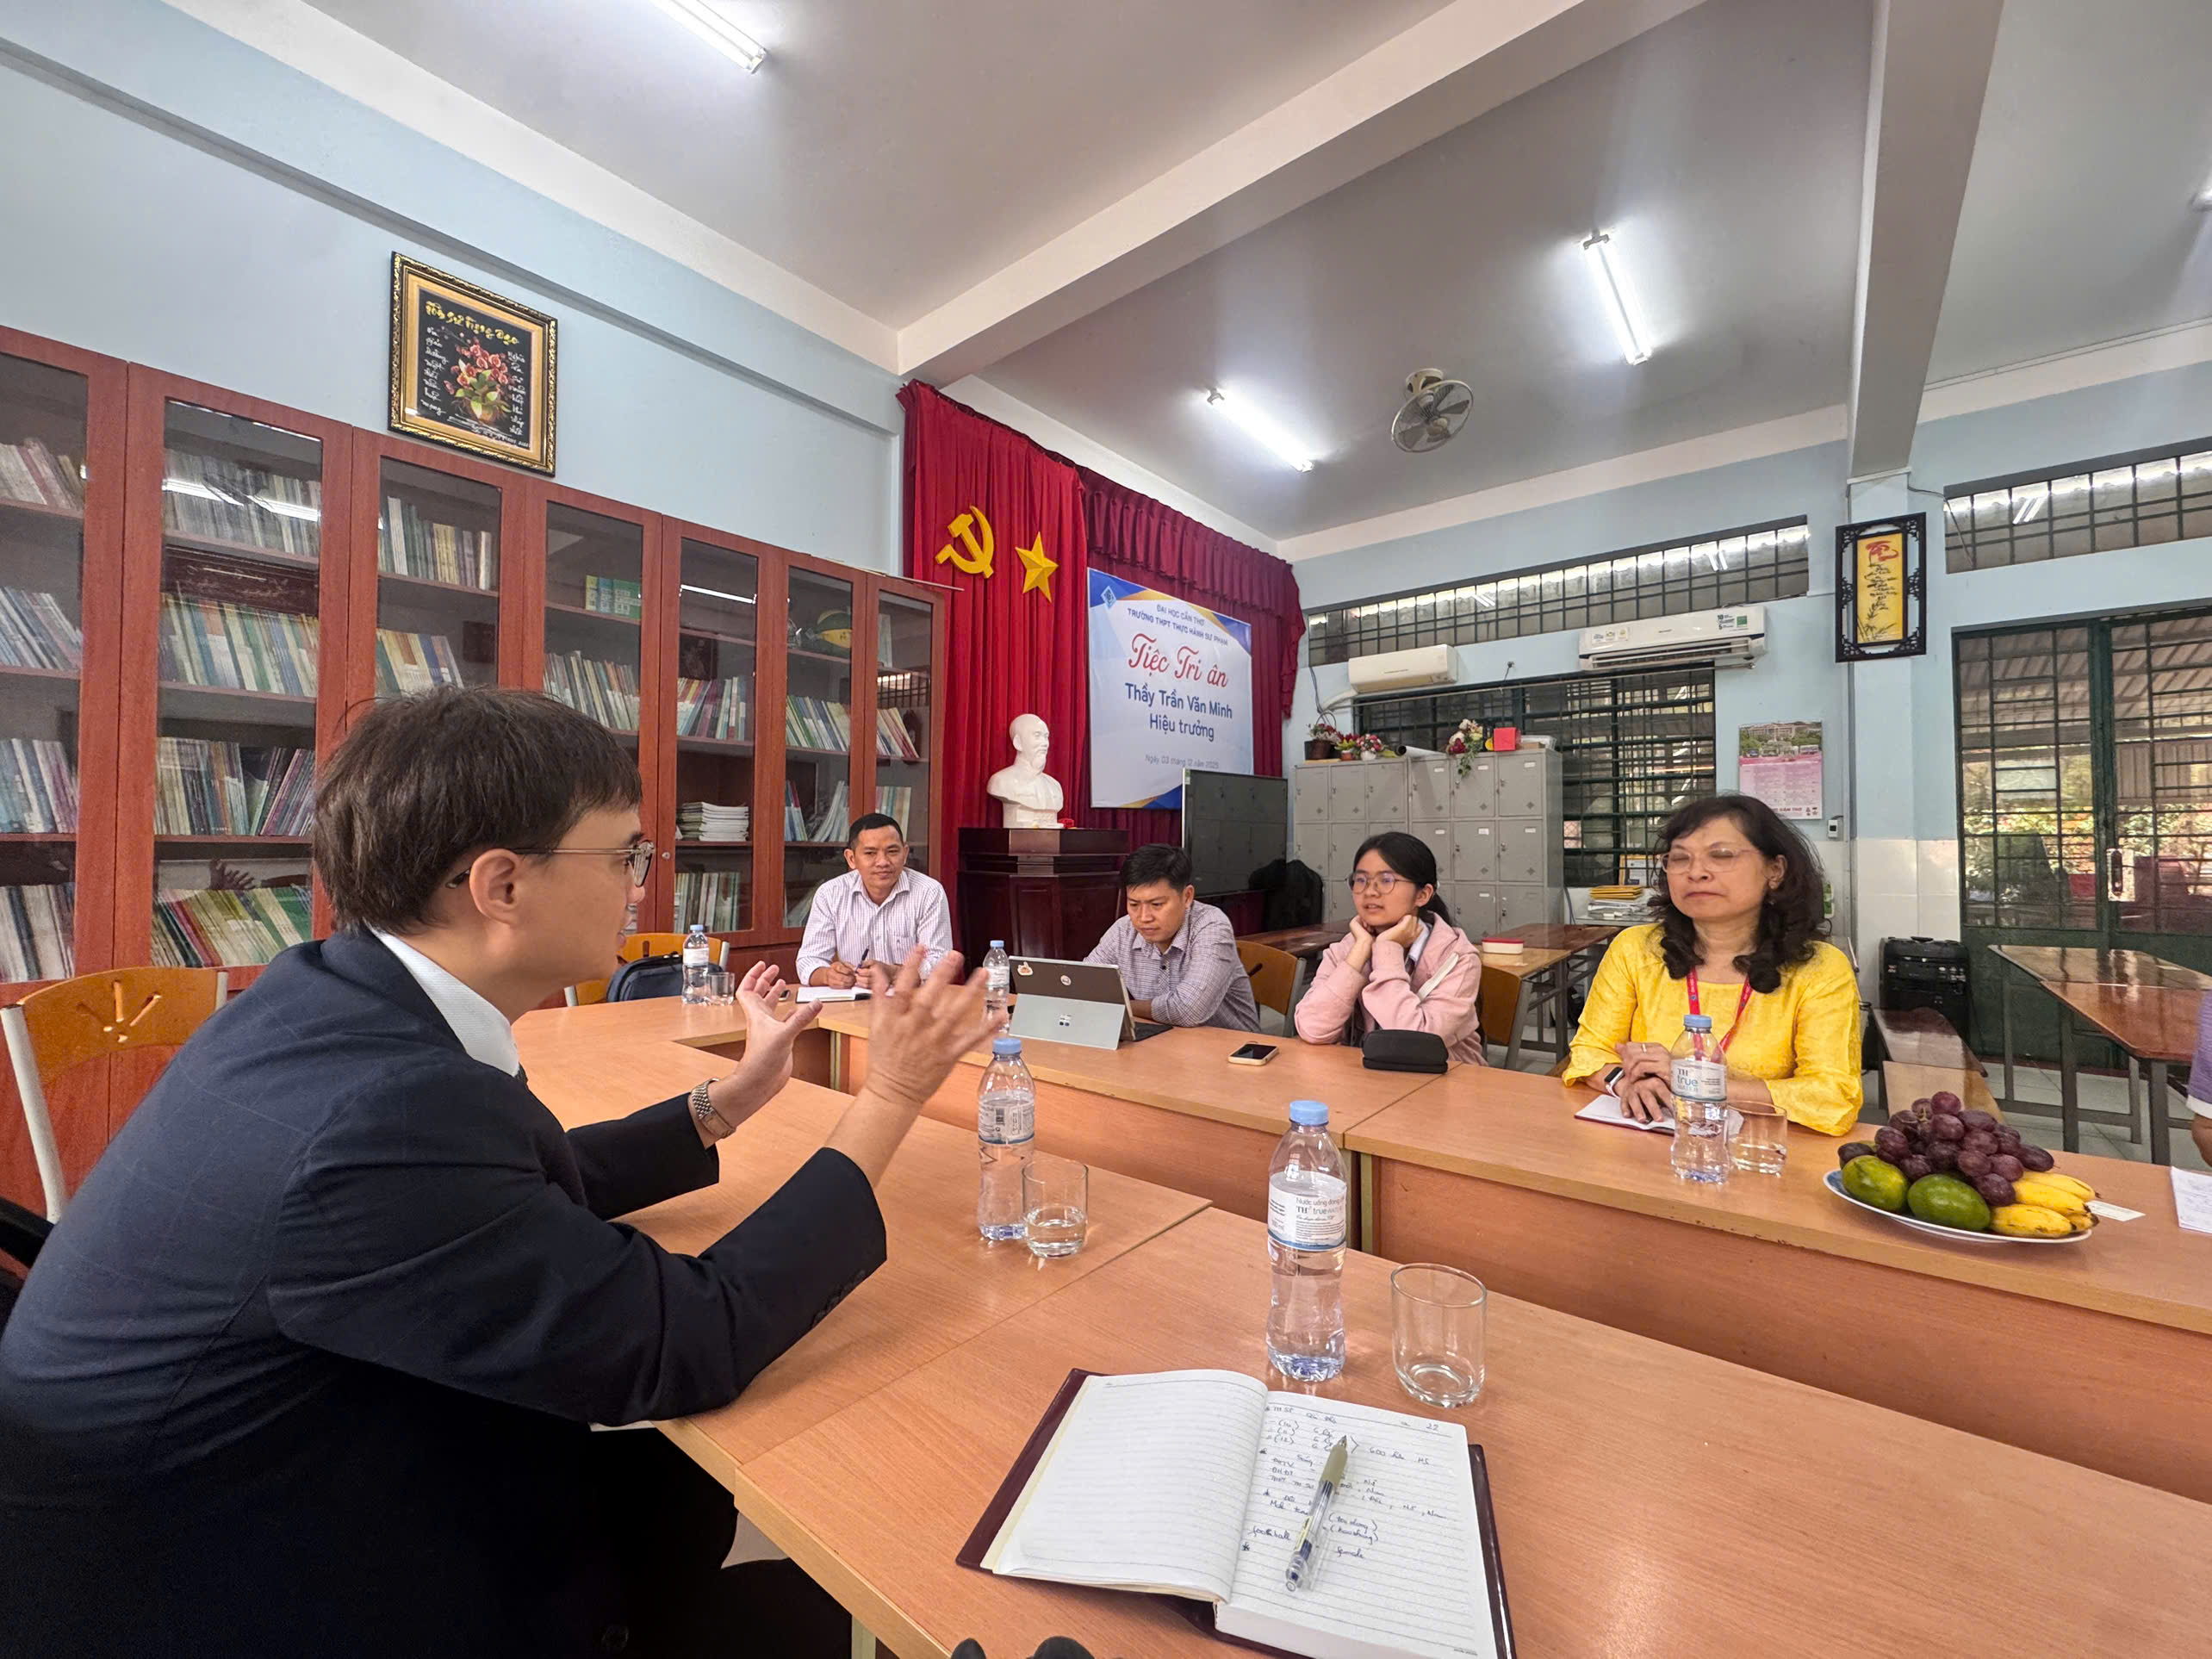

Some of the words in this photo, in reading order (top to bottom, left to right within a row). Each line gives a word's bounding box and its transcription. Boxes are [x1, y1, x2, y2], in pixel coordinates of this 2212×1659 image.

[1127, 607, 1154, 623] TRƯỜNG
[1155, 617, 1171, 628] THPT
[1189, 627, 1205, 639] HÀNH
[1128, 633, 1170, 677] Tiệc
[1174, 646, 1202, 681] Tri
[1207, 664, 1229, 688] ân
[1124, 682, 1155, 708] Thầy
[1159, 689, 1184, 710] Trần
[1186, 695, 1207, 714] Văn
[1209, 700, 1233, 719] Minh
[1149, 713, 1176, 735] Hiệu
[1178, 719, 1215, 743] trưởng
[1677, 1075, 1699, 1086] true
